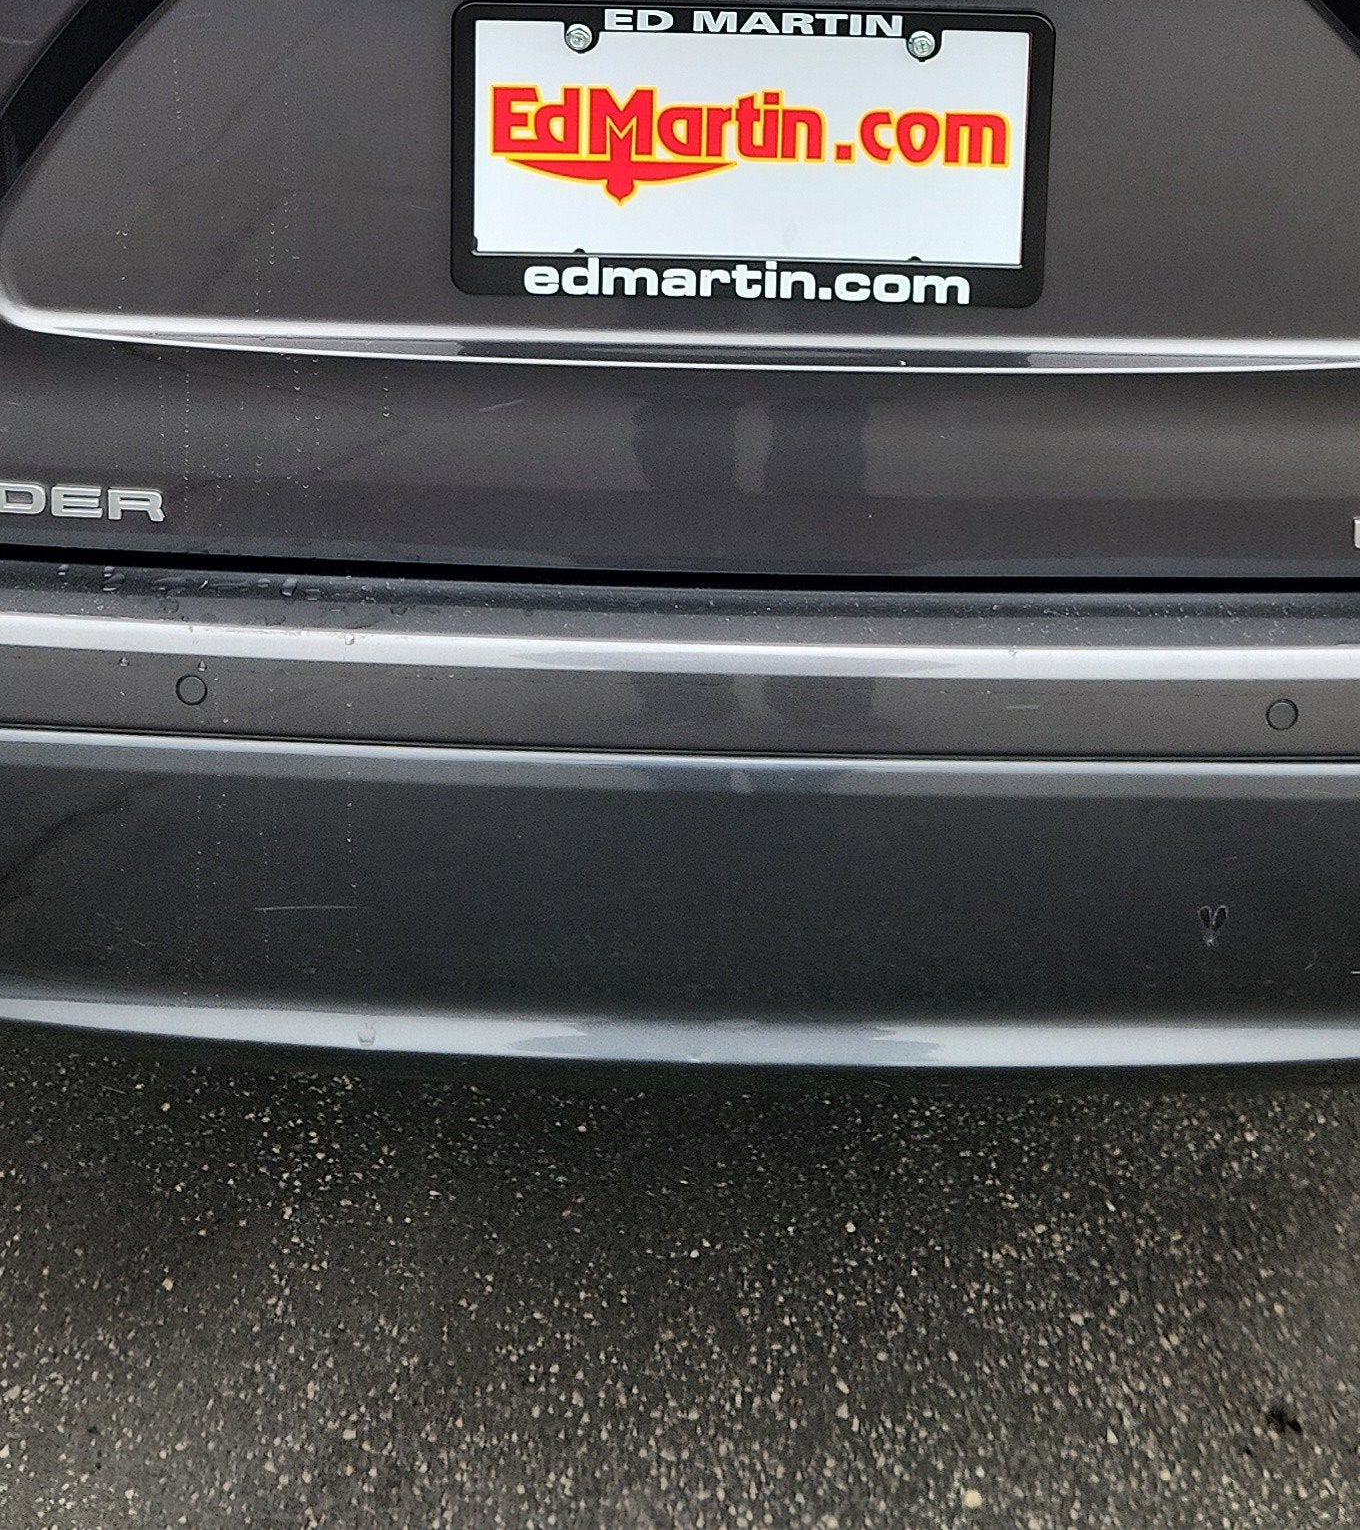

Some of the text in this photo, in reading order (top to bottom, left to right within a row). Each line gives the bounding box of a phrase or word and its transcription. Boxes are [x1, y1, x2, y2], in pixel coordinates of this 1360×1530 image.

[603, 9, 903, 37] ED MARTIN
[490, 85, 1010, 168] EdMartin.com
[524, 258, 971, 305] edmartin.com
